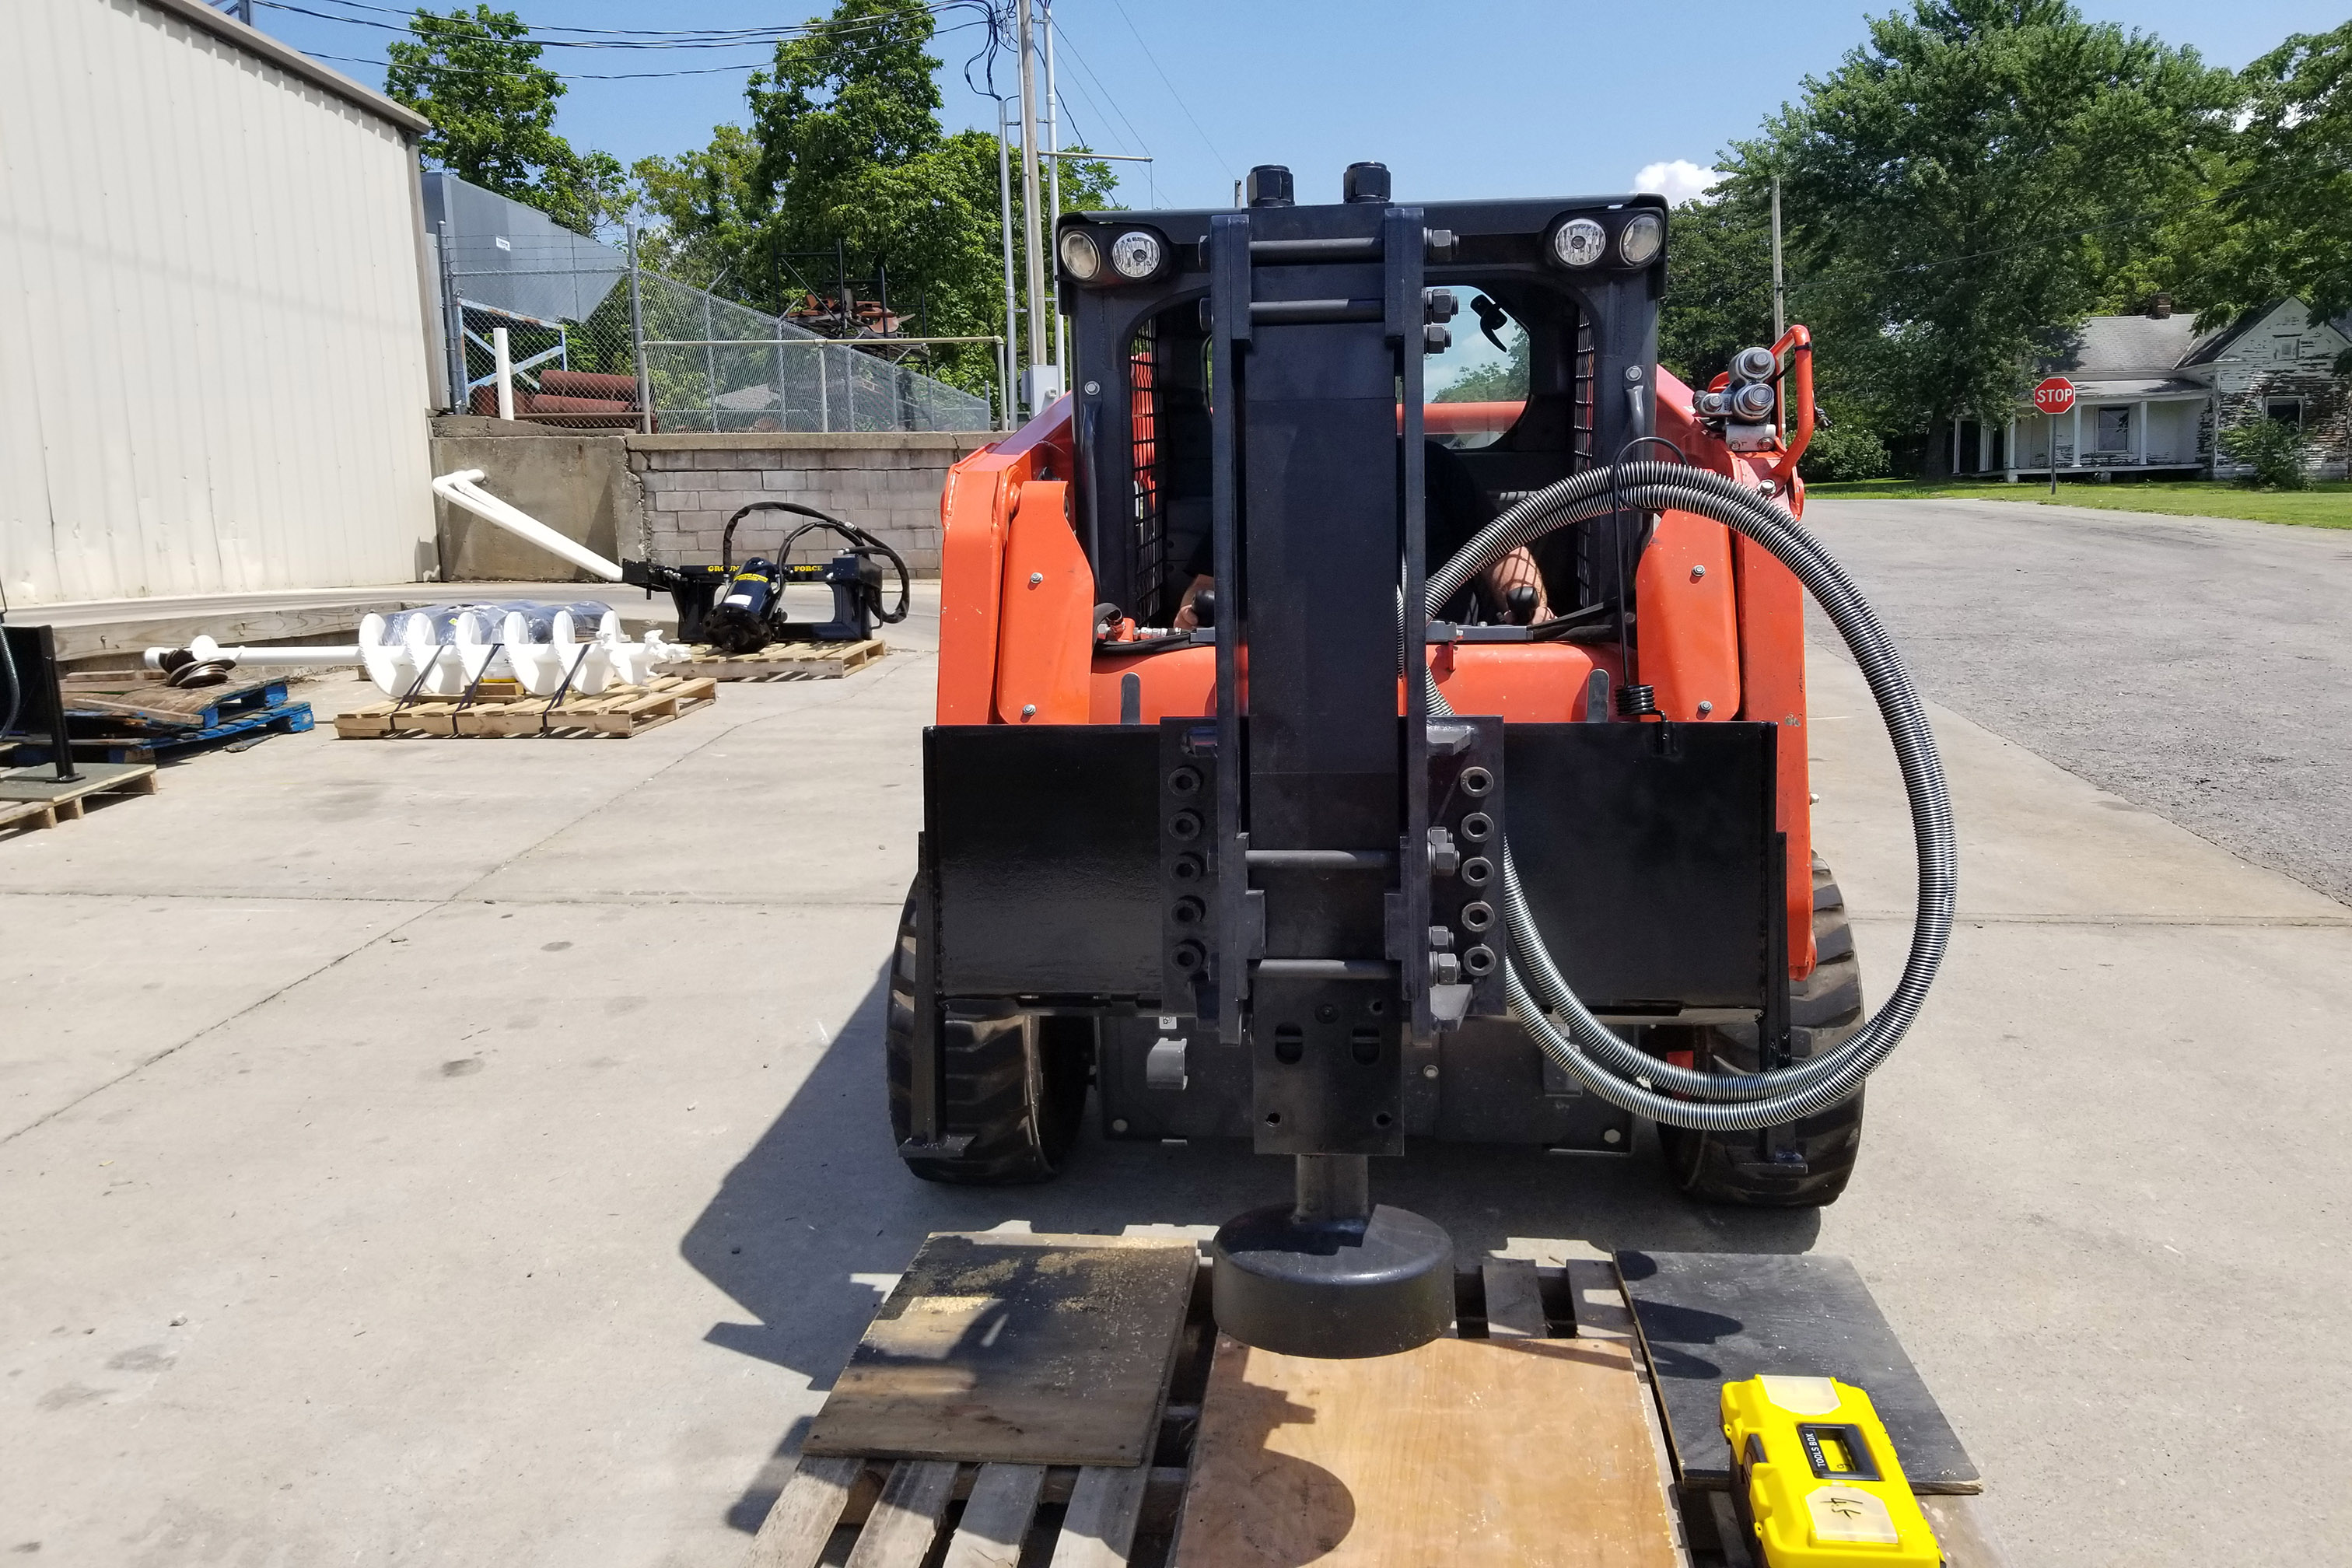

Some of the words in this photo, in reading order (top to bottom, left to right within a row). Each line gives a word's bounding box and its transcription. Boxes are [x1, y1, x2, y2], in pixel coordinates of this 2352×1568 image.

[2036, 388, 2073, 403] STOP
[1805, 1433, 1818, 1446] BOX
[1811, 1447, 1825, 1467] TOOLS
